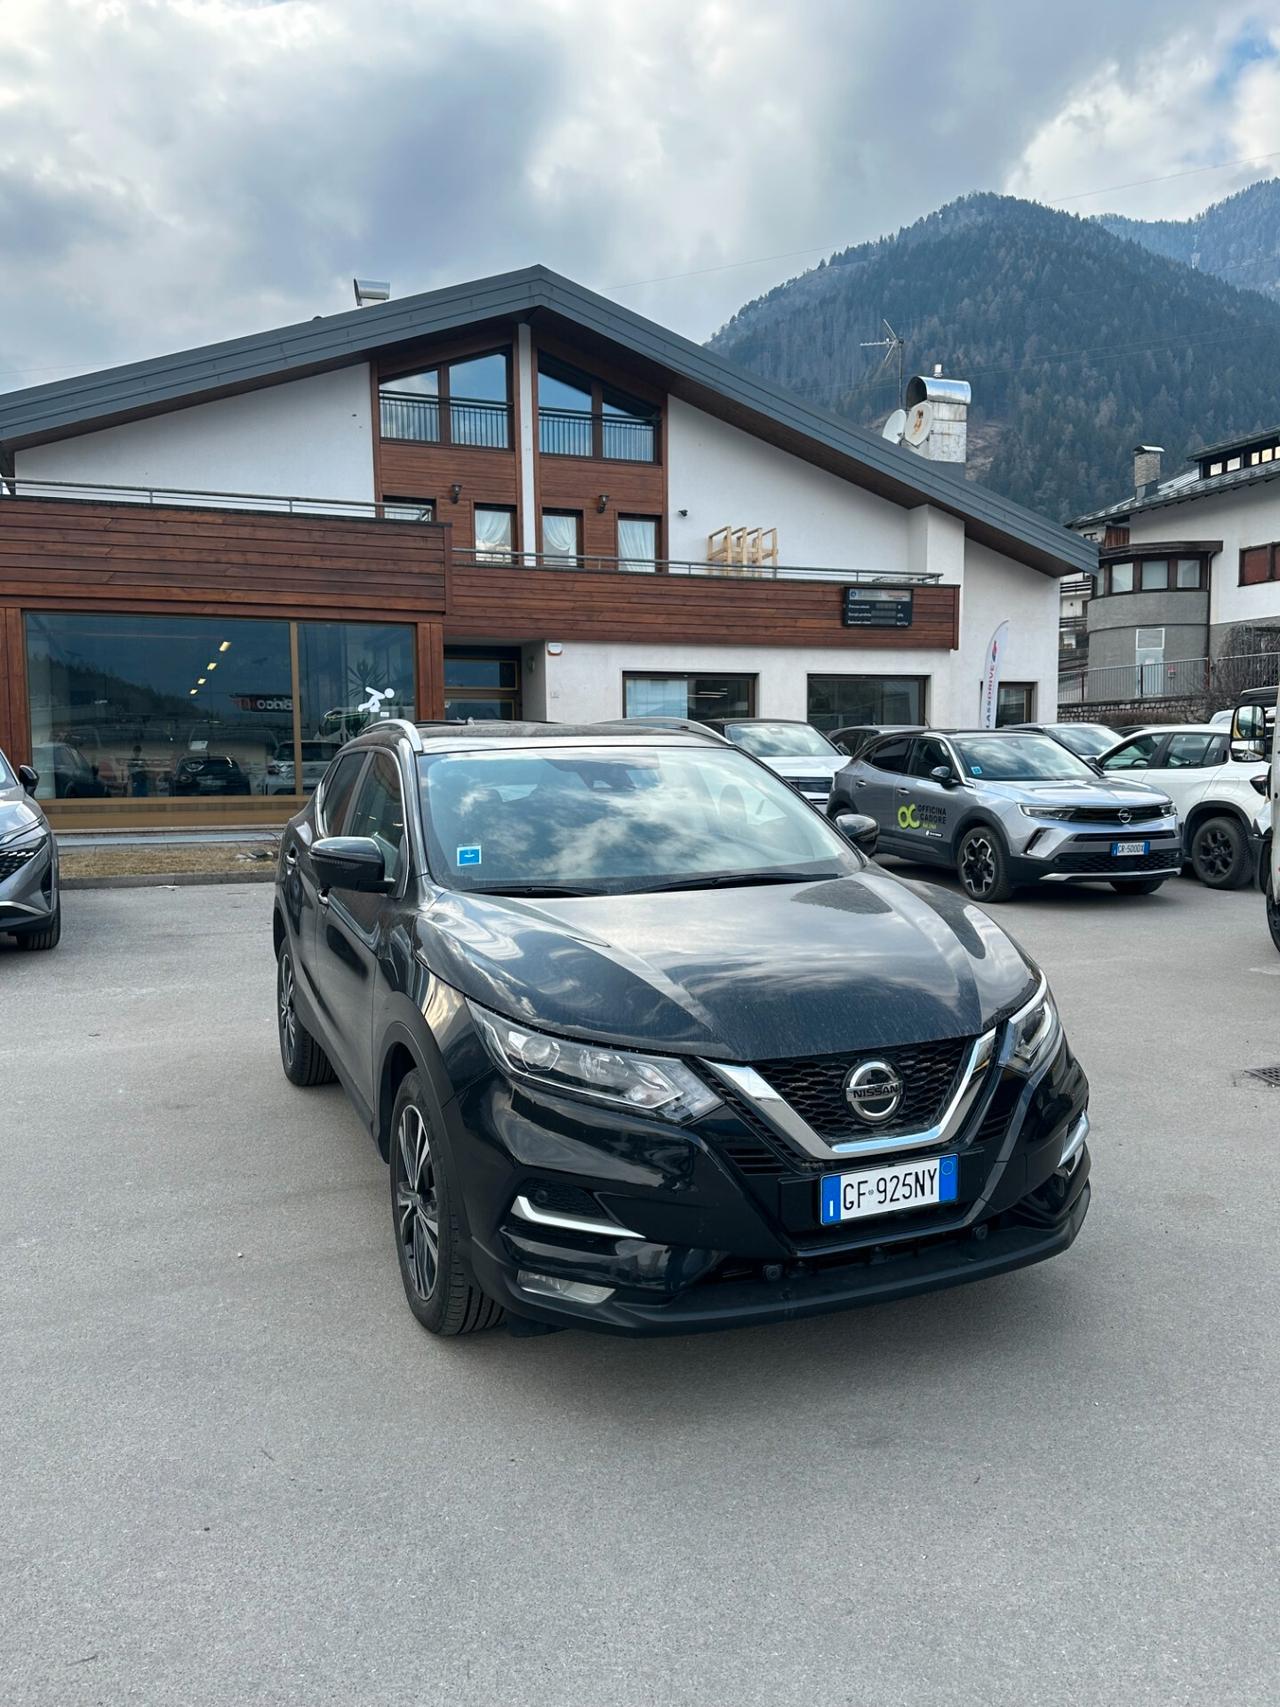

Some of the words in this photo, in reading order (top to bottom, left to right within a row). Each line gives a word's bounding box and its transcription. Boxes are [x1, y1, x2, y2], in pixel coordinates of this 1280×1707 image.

[985, 664, 995, 729] LASSDRIVE
[918, 804, 947, 816] OFFICINA
[853, 1083, 899, 1099] NISSAN
